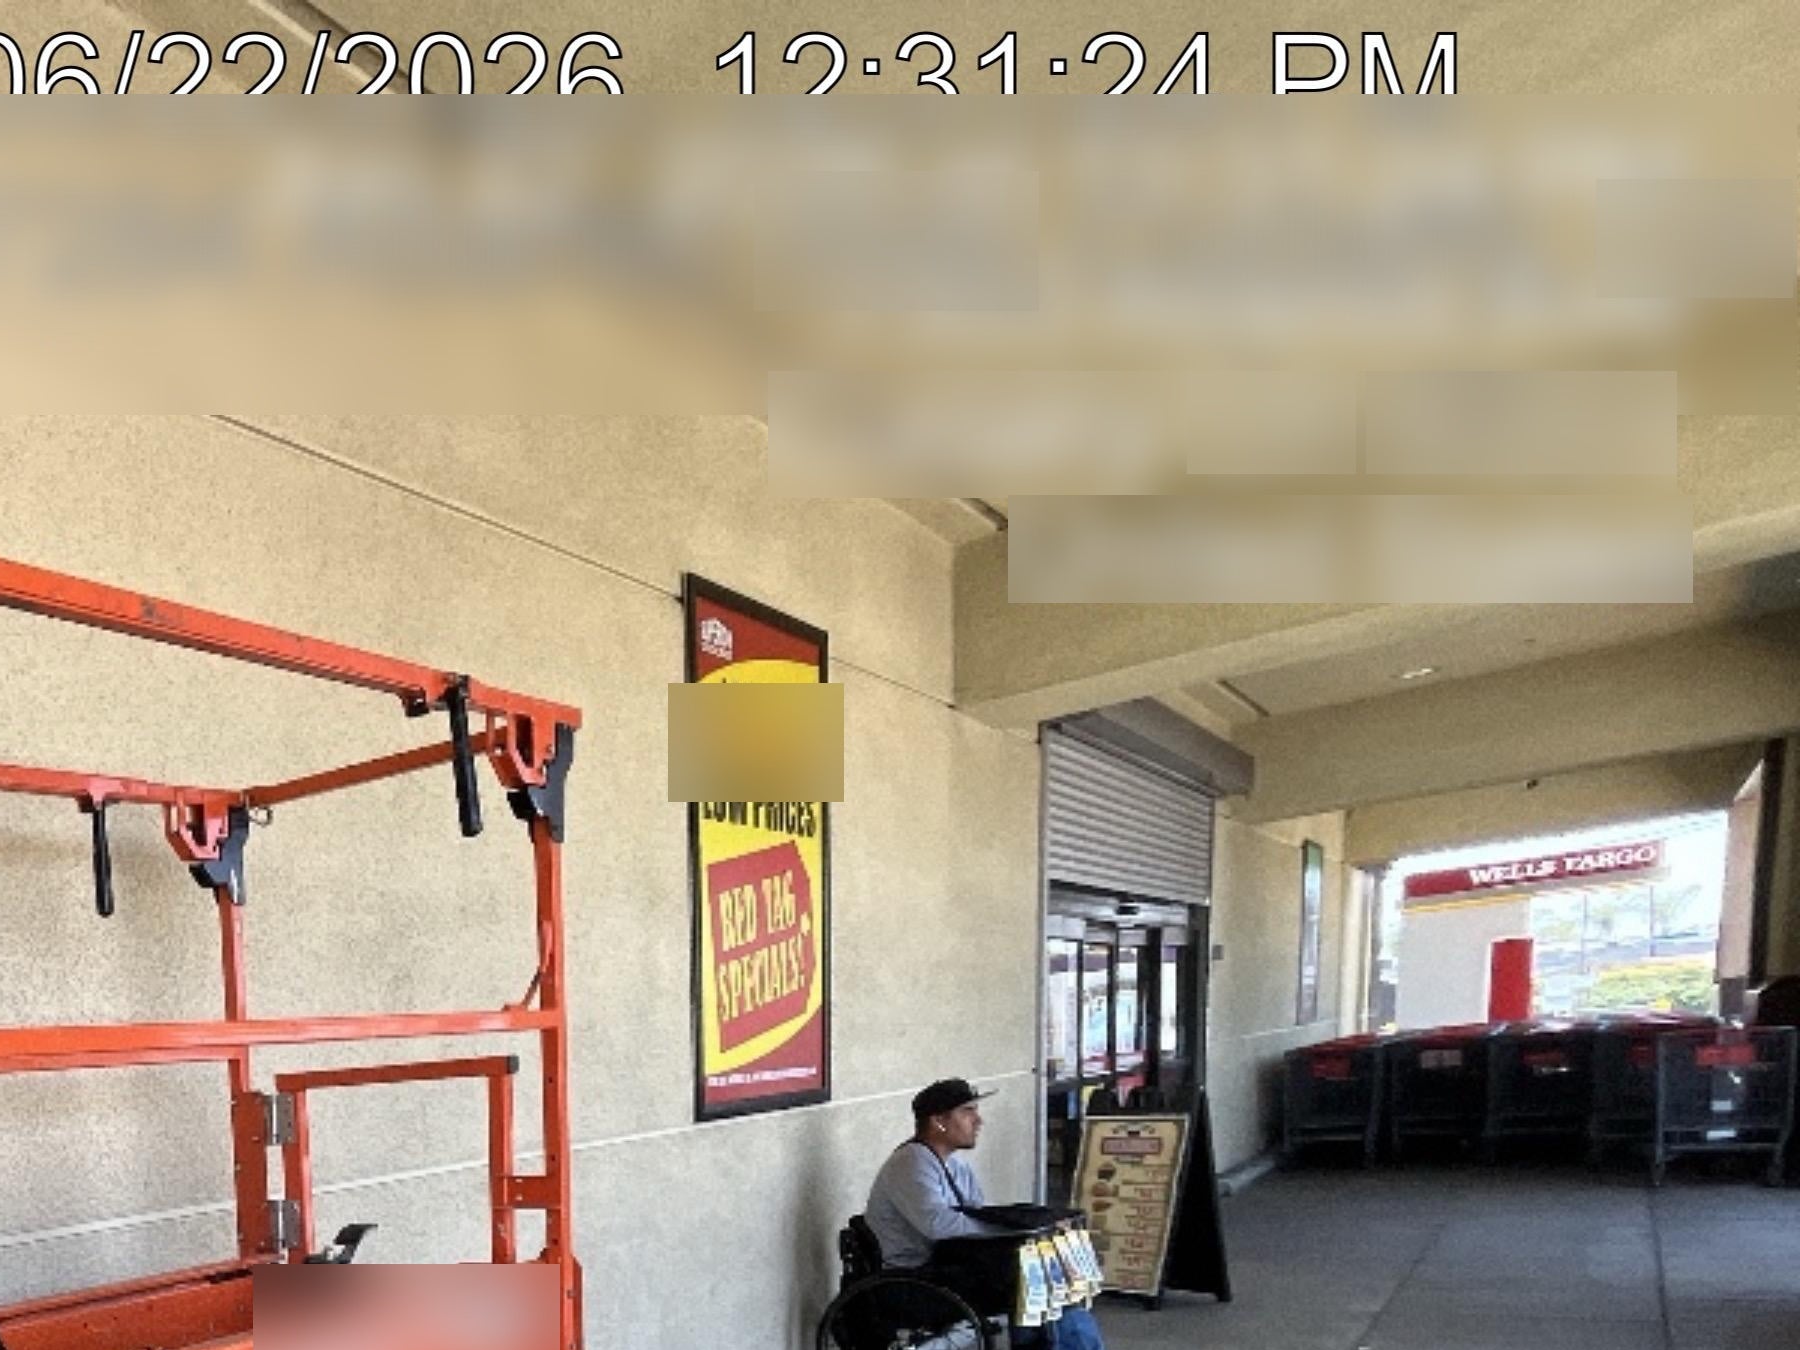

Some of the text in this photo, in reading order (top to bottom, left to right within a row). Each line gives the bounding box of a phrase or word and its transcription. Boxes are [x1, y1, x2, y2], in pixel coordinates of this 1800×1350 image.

[1469, 845, 1657, 885] WELLS FARGO
[718, 870, 797, 952] RED TAG
[719, 932, 806, 1022] SPECIALS!
